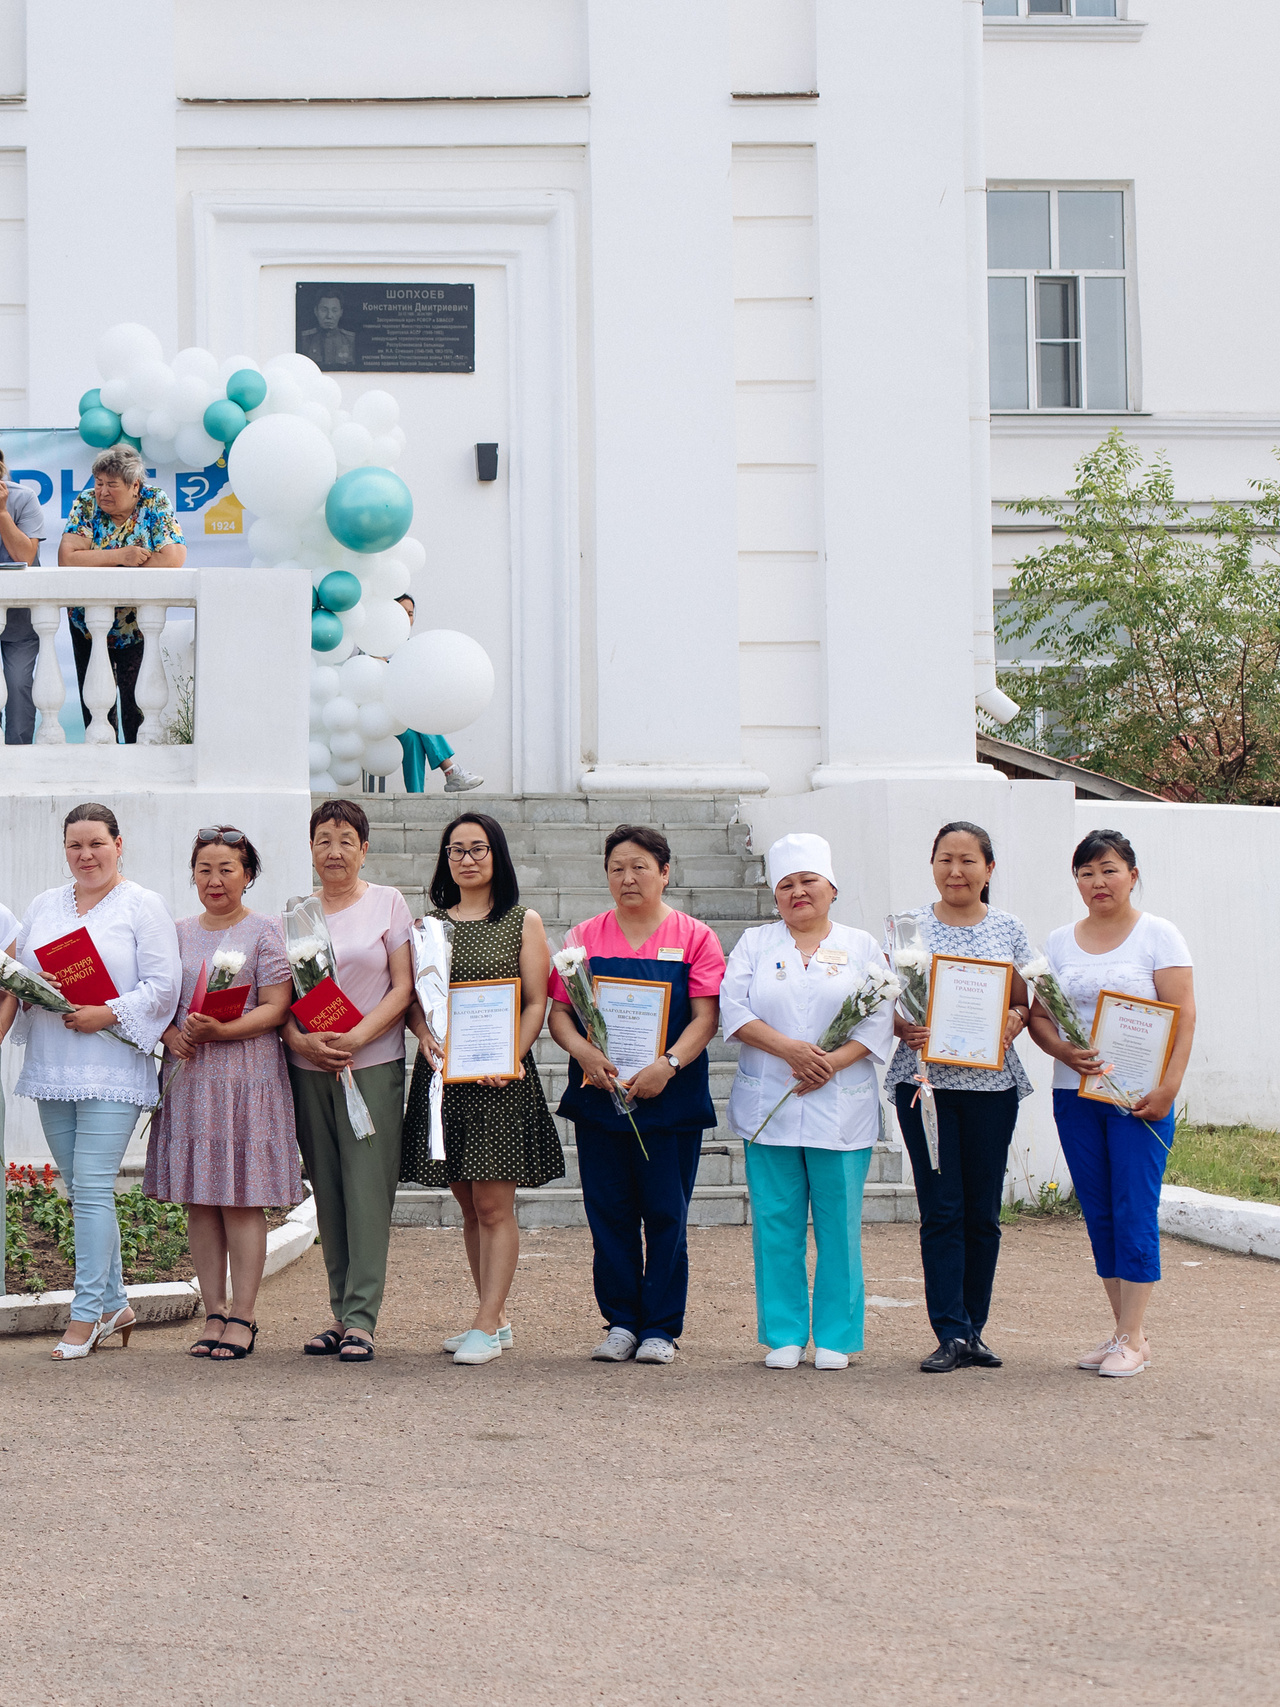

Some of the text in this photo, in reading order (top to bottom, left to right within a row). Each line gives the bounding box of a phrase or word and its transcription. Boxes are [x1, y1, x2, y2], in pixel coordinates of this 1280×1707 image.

[386, 289, 445, 299] ШОПХОЕВ
[362, 302, 468, 314] Константин Дмитриевич
[211, 521, 236, 531] 1924
[54, 956, 94, 981] ПОЧЕТНАЯ
[61, 965, 96, 988] ГРАМОТА
[953, 978, 988, 988] ПОЧЕТНАЯ
[955, 986, 985, 994] ГРАМОТА
[309, 996, 344, 1028] ПОЧЕТНАЯ
[317, 1005, 348, 1032] ГРАМОТА
[1118, 1016, 1153, 1028] ПОЧЕТНАЯ
[1119, 1023, 1149, 1034] ГРАМОТА
